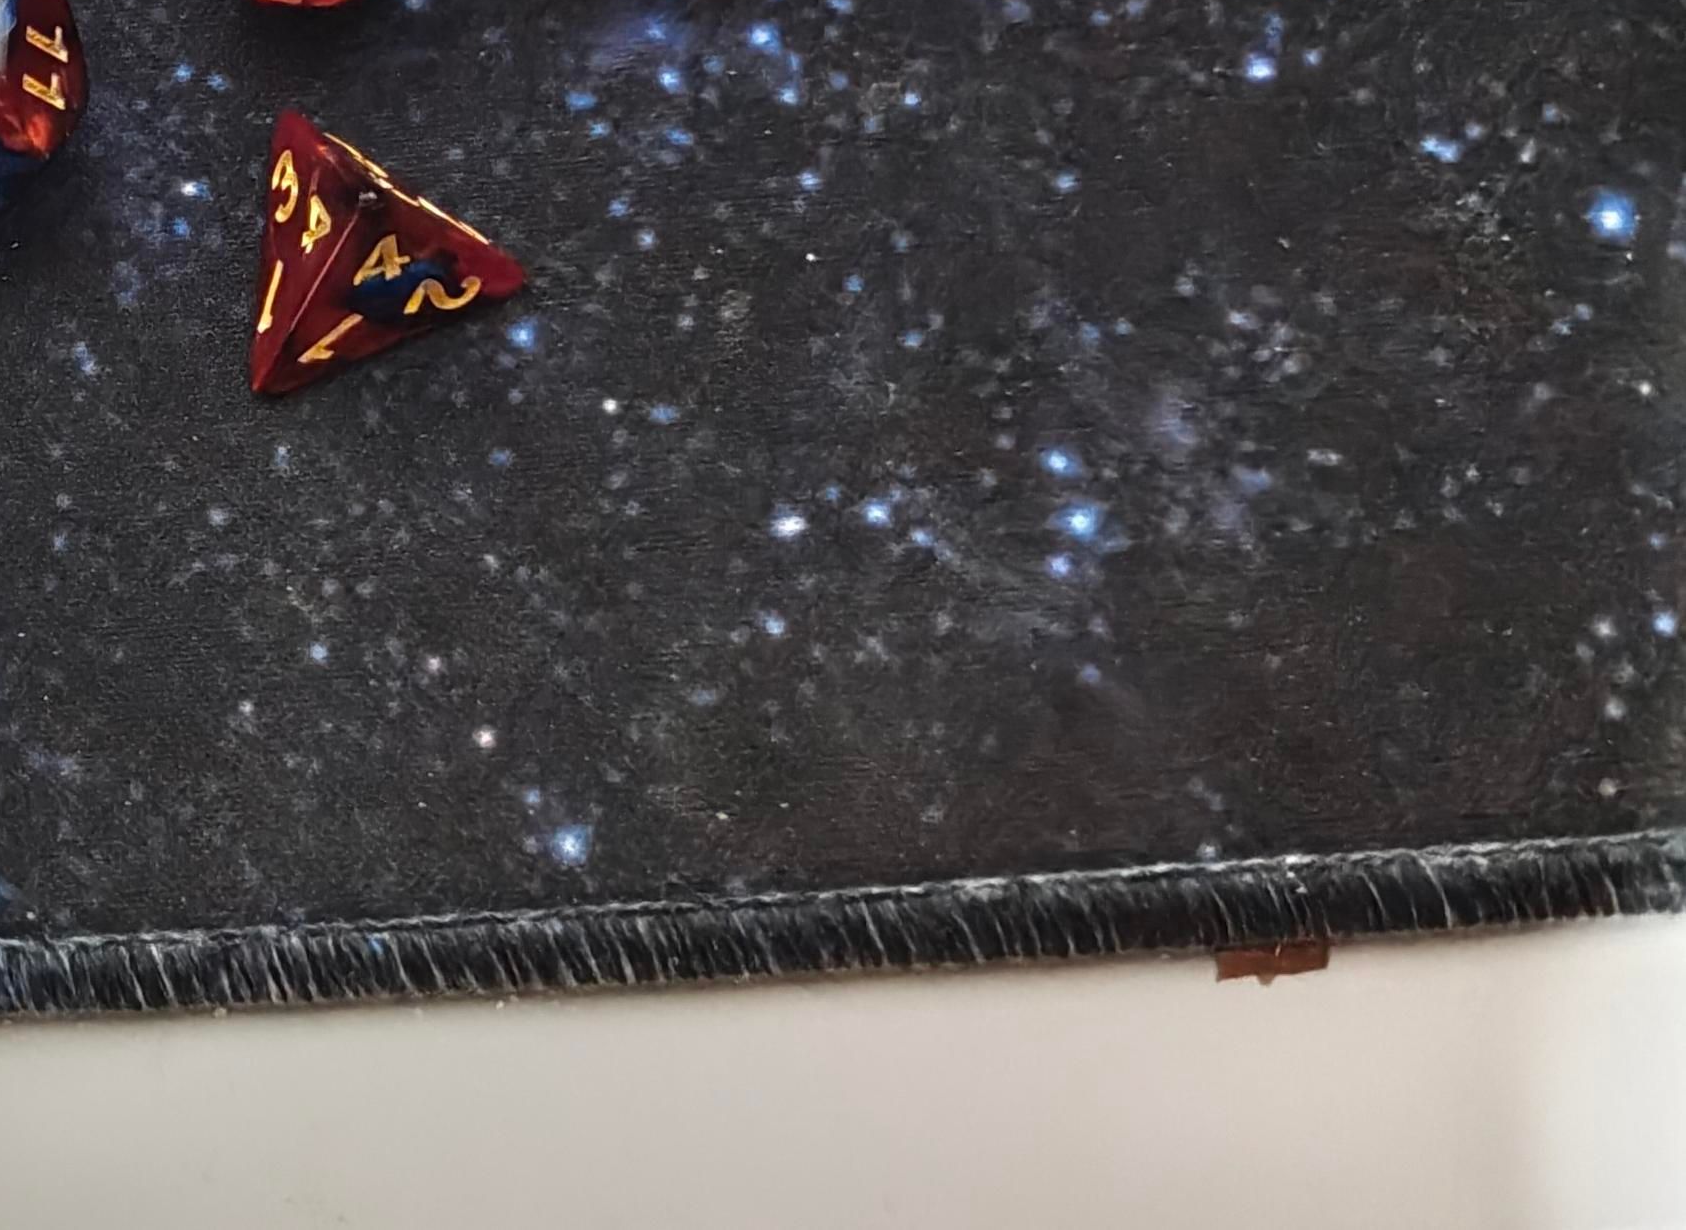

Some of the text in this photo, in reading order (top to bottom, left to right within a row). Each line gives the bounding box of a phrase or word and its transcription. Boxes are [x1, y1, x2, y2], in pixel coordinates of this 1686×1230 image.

[271, 149, 299, 223] 3
[301, 194, 332, 254] 4
[353, 233, 411, 286] 4
[257, 259, 284, 334] 1
[403, 275, 482, 315] 2
[297, 313, 364, 363] 1
